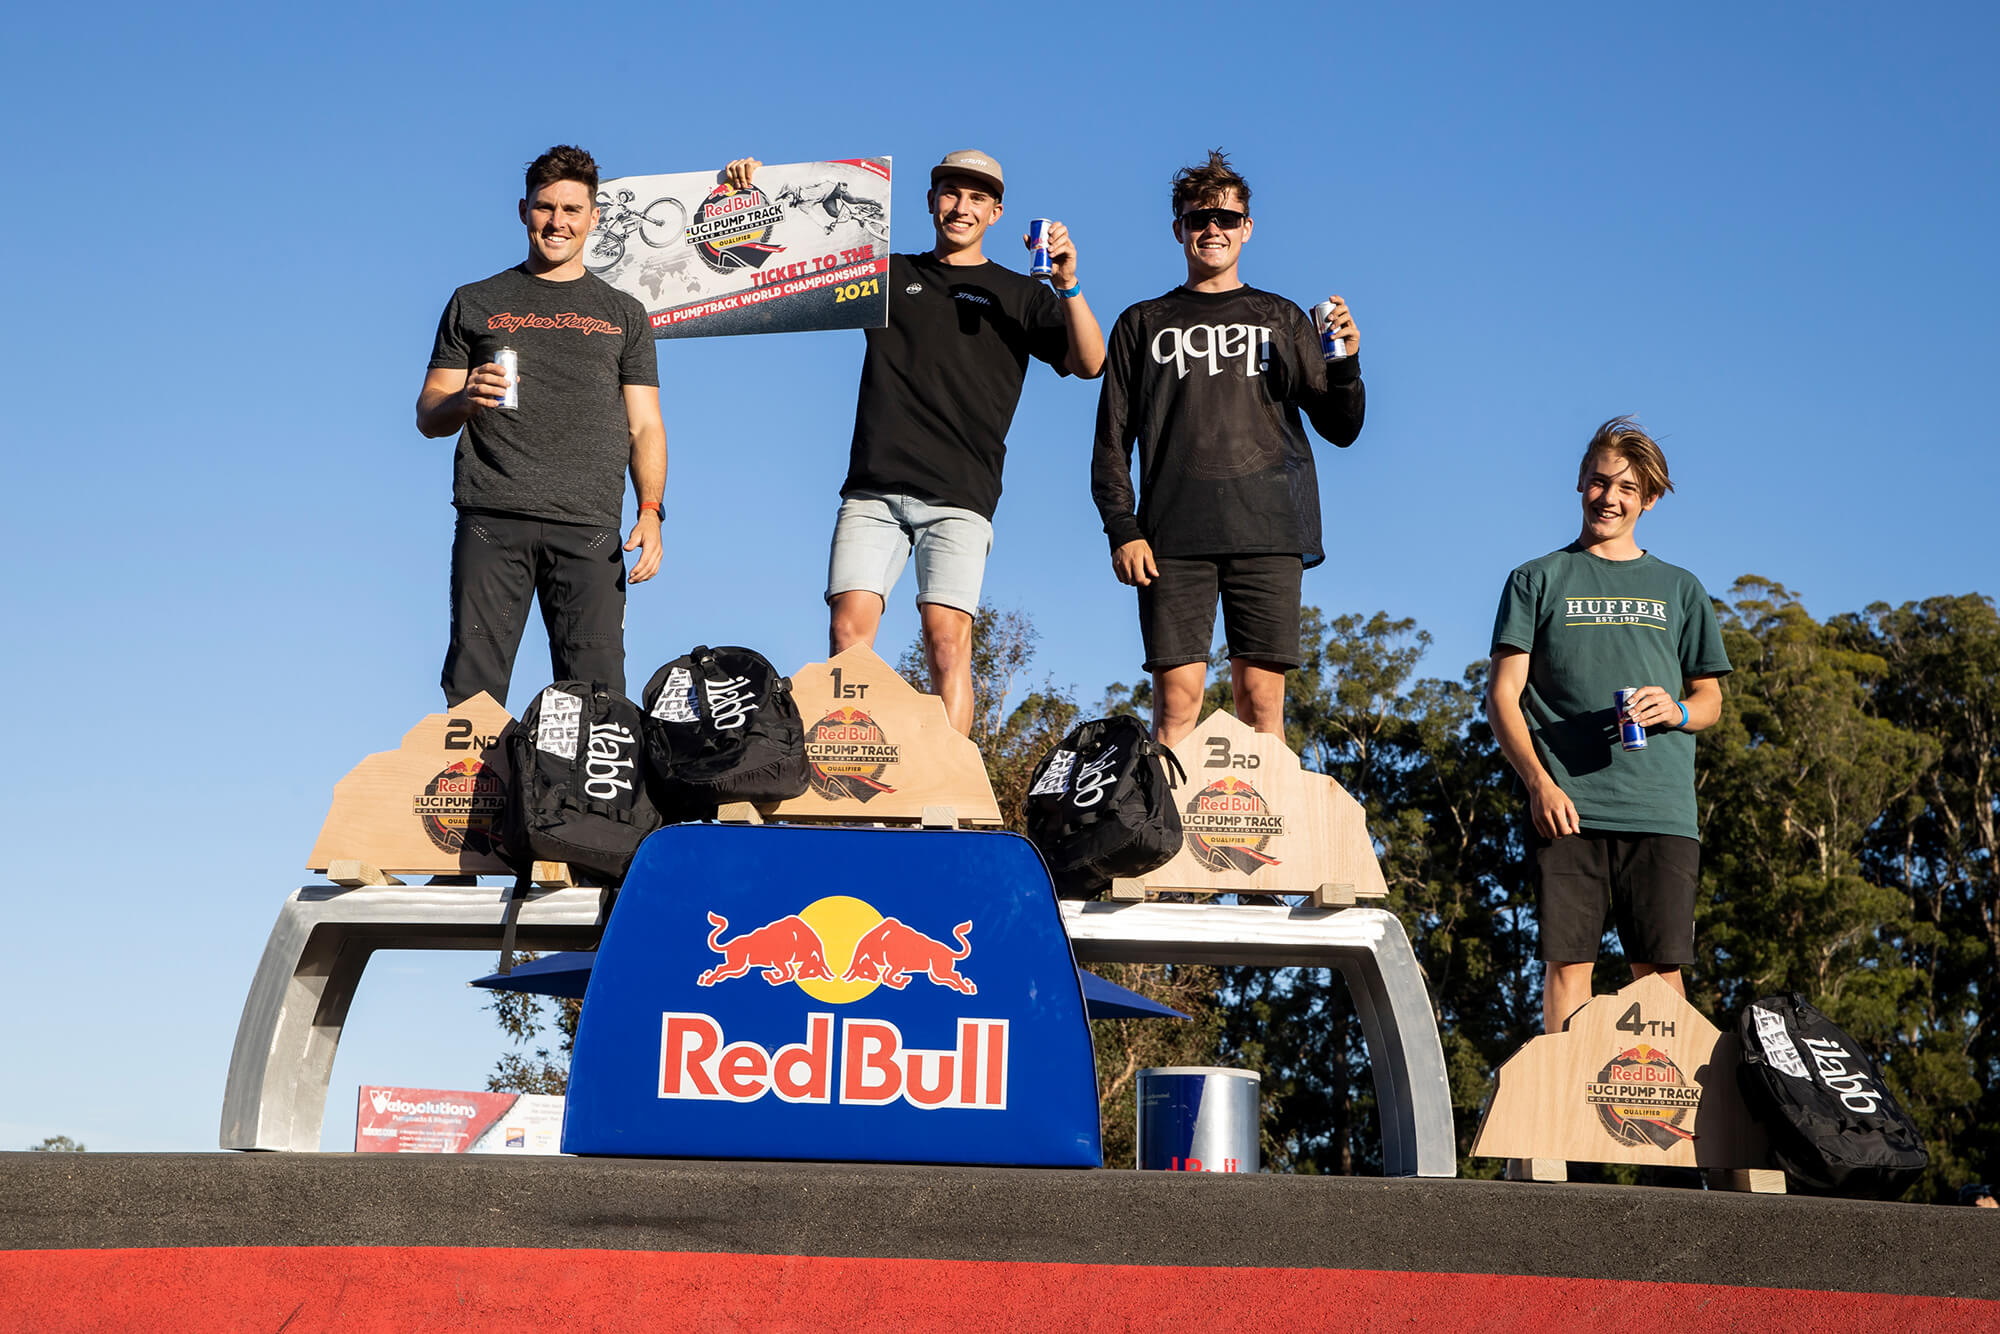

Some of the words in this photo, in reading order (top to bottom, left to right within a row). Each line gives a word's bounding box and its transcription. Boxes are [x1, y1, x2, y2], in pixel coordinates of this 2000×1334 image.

[705, 198, 732, 217] Red
[734, 192, 760, 210] Bull
[691, 224, 712, 236] UCI
[714, 214, 745, 231] PUMP
[747, 204, 783, 221] TRACK
[719, 234, 751, 246] QUALIFIER
[750, 261, 807, 287] TICKET
[812, 254, 838, 271] TO
[840, 244, 875, 264] THE
[652, 315, 671, 326] UCI
[673, 297, 739, 321] PUMPTRACK
[740, 287, 781, 304] WORLD
[784, 264, 876, 293] CHAMPIONSHIPS
[834, 278, 879, 303] 2021
[488, 312, 523, 333] Troy
[521, 313, 555, 329] Lee
[555, 312, 622, 336] Designs
[1152, 323, 1273, 379] ilabb
[1566, 600, 1666, 618] HUFFER
[830, 668, 869, 699] 1ST
[445, 718, 500, 750] 2ND
[818, 726, 846, 740] Red
[849, 727, 876, 740] Bull
[584, 721, 635, 800] ilabb
[825, 745, 858, 754] PUMP
[861, 746, 898, 756] TRACK
[1204, 737, 1260, 769] 3RD
[439, 779, 467, 792] Red
[470, 779, 497, 793] Bull
[421, 797, 443, 807] UCI
[446, 797, 479, 807] PUMP
[482, 797, 504, 808] TRA
[1201, 796, 1229, 810] Red
[1232, 797, 1259, 811] Bull
[1182, 815, 1205, 824] UCI
[1208, 816, 1242, 826] PUMP
[1244, 817, 1282, 827] TRACK
[1616, 1001, 1675, 1037] 4TH
[657, 1011, 835, 1104] Red
[839, 1017, 1009, 1111] Bull
[1612, 1065, 1642, 1080] Red
[1646, 1067, 1675, 1082] Bull
[1801, 1036, 1883, 1114] ilabb
[1593, 1085, 1617, 1095] UCI
[1620, 1086, 1656, 1097] PUMP
[1659, 1088, 1700, 1100] TRACK
